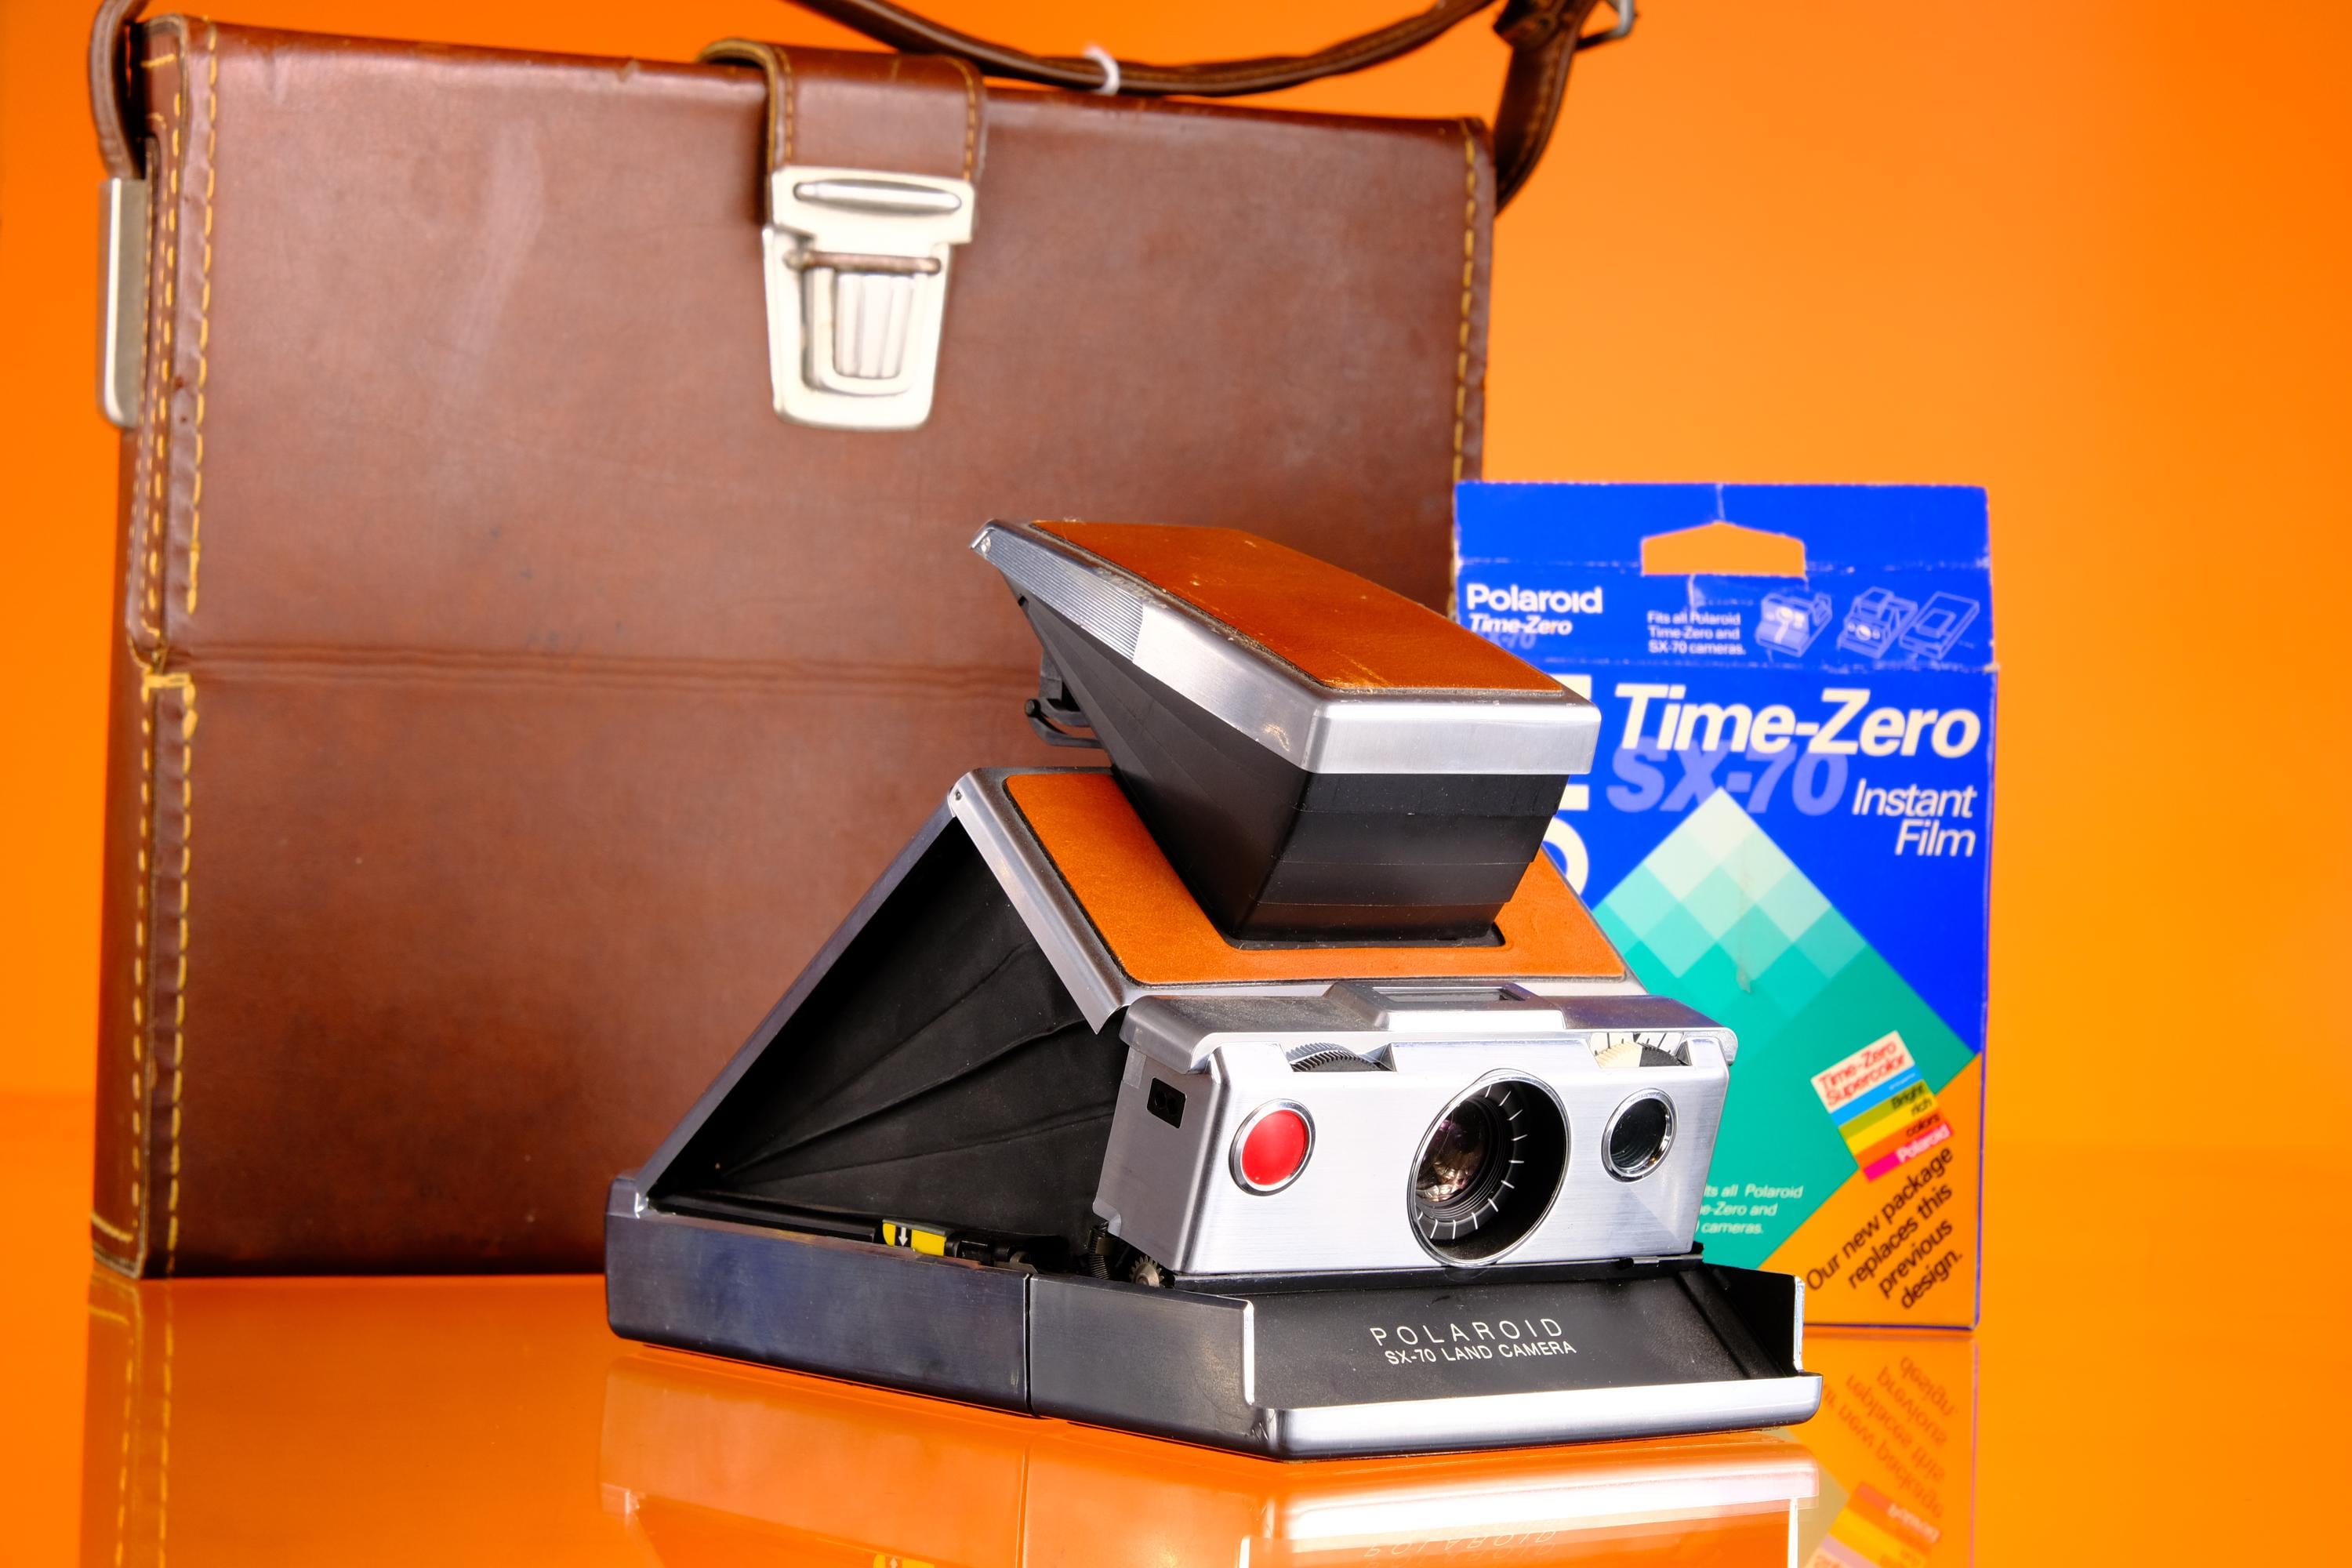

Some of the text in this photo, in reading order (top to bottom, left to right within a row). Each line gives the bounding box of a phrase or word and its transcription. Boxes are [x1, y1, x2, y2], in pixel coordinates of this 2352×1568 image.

[1466, 583, 1603, 614] Polaroid
[1469, 612, 1573, 636] Time-Zero
[1647, 611, 1741, 626] Fits all Polaroid
[1648, 625, 1740, 640] Time-Zero and
[1648, 639, 1747, 655] SX-70 cameras.
[1615, 684, 1981, 758] Time-Zero
[1606, 735, 1848, 815] SX-70
[1852, 779, 1977, 819] Instant
[1895, 818, 1976, 857] Film
[1819, 1041, 1896, 1087] Time-Zero
[1825, 1054, 1905, 1107] Supercolor
[1891, 1084, 1924, 1110] Bright
[1910, 1098, 1933, 1116] rich
[1906, 1113, 1940, 1138] colors
[1896, 1123, 1951, 1163] Polaroid
[1721, 1184, 1739, 1198] all
[1744, 1183, 1804, 1199] Polaroid
[1749, 1203, 1778, 1216] and
[1806, 1147, 1954, 1290] Our new package
[1700, 1222, 1764, 1235] cameras.
[1847, 1183, 1953, 1290] replaces this
[1878, 1219, 1954, 1300] previous
[1900, 1249, 1963, 1310] design.
[1370, 1318, 1563, 1346] POLAROID
[1385, 1341, 1577, 1365] SX-70 LAND CAMERA
